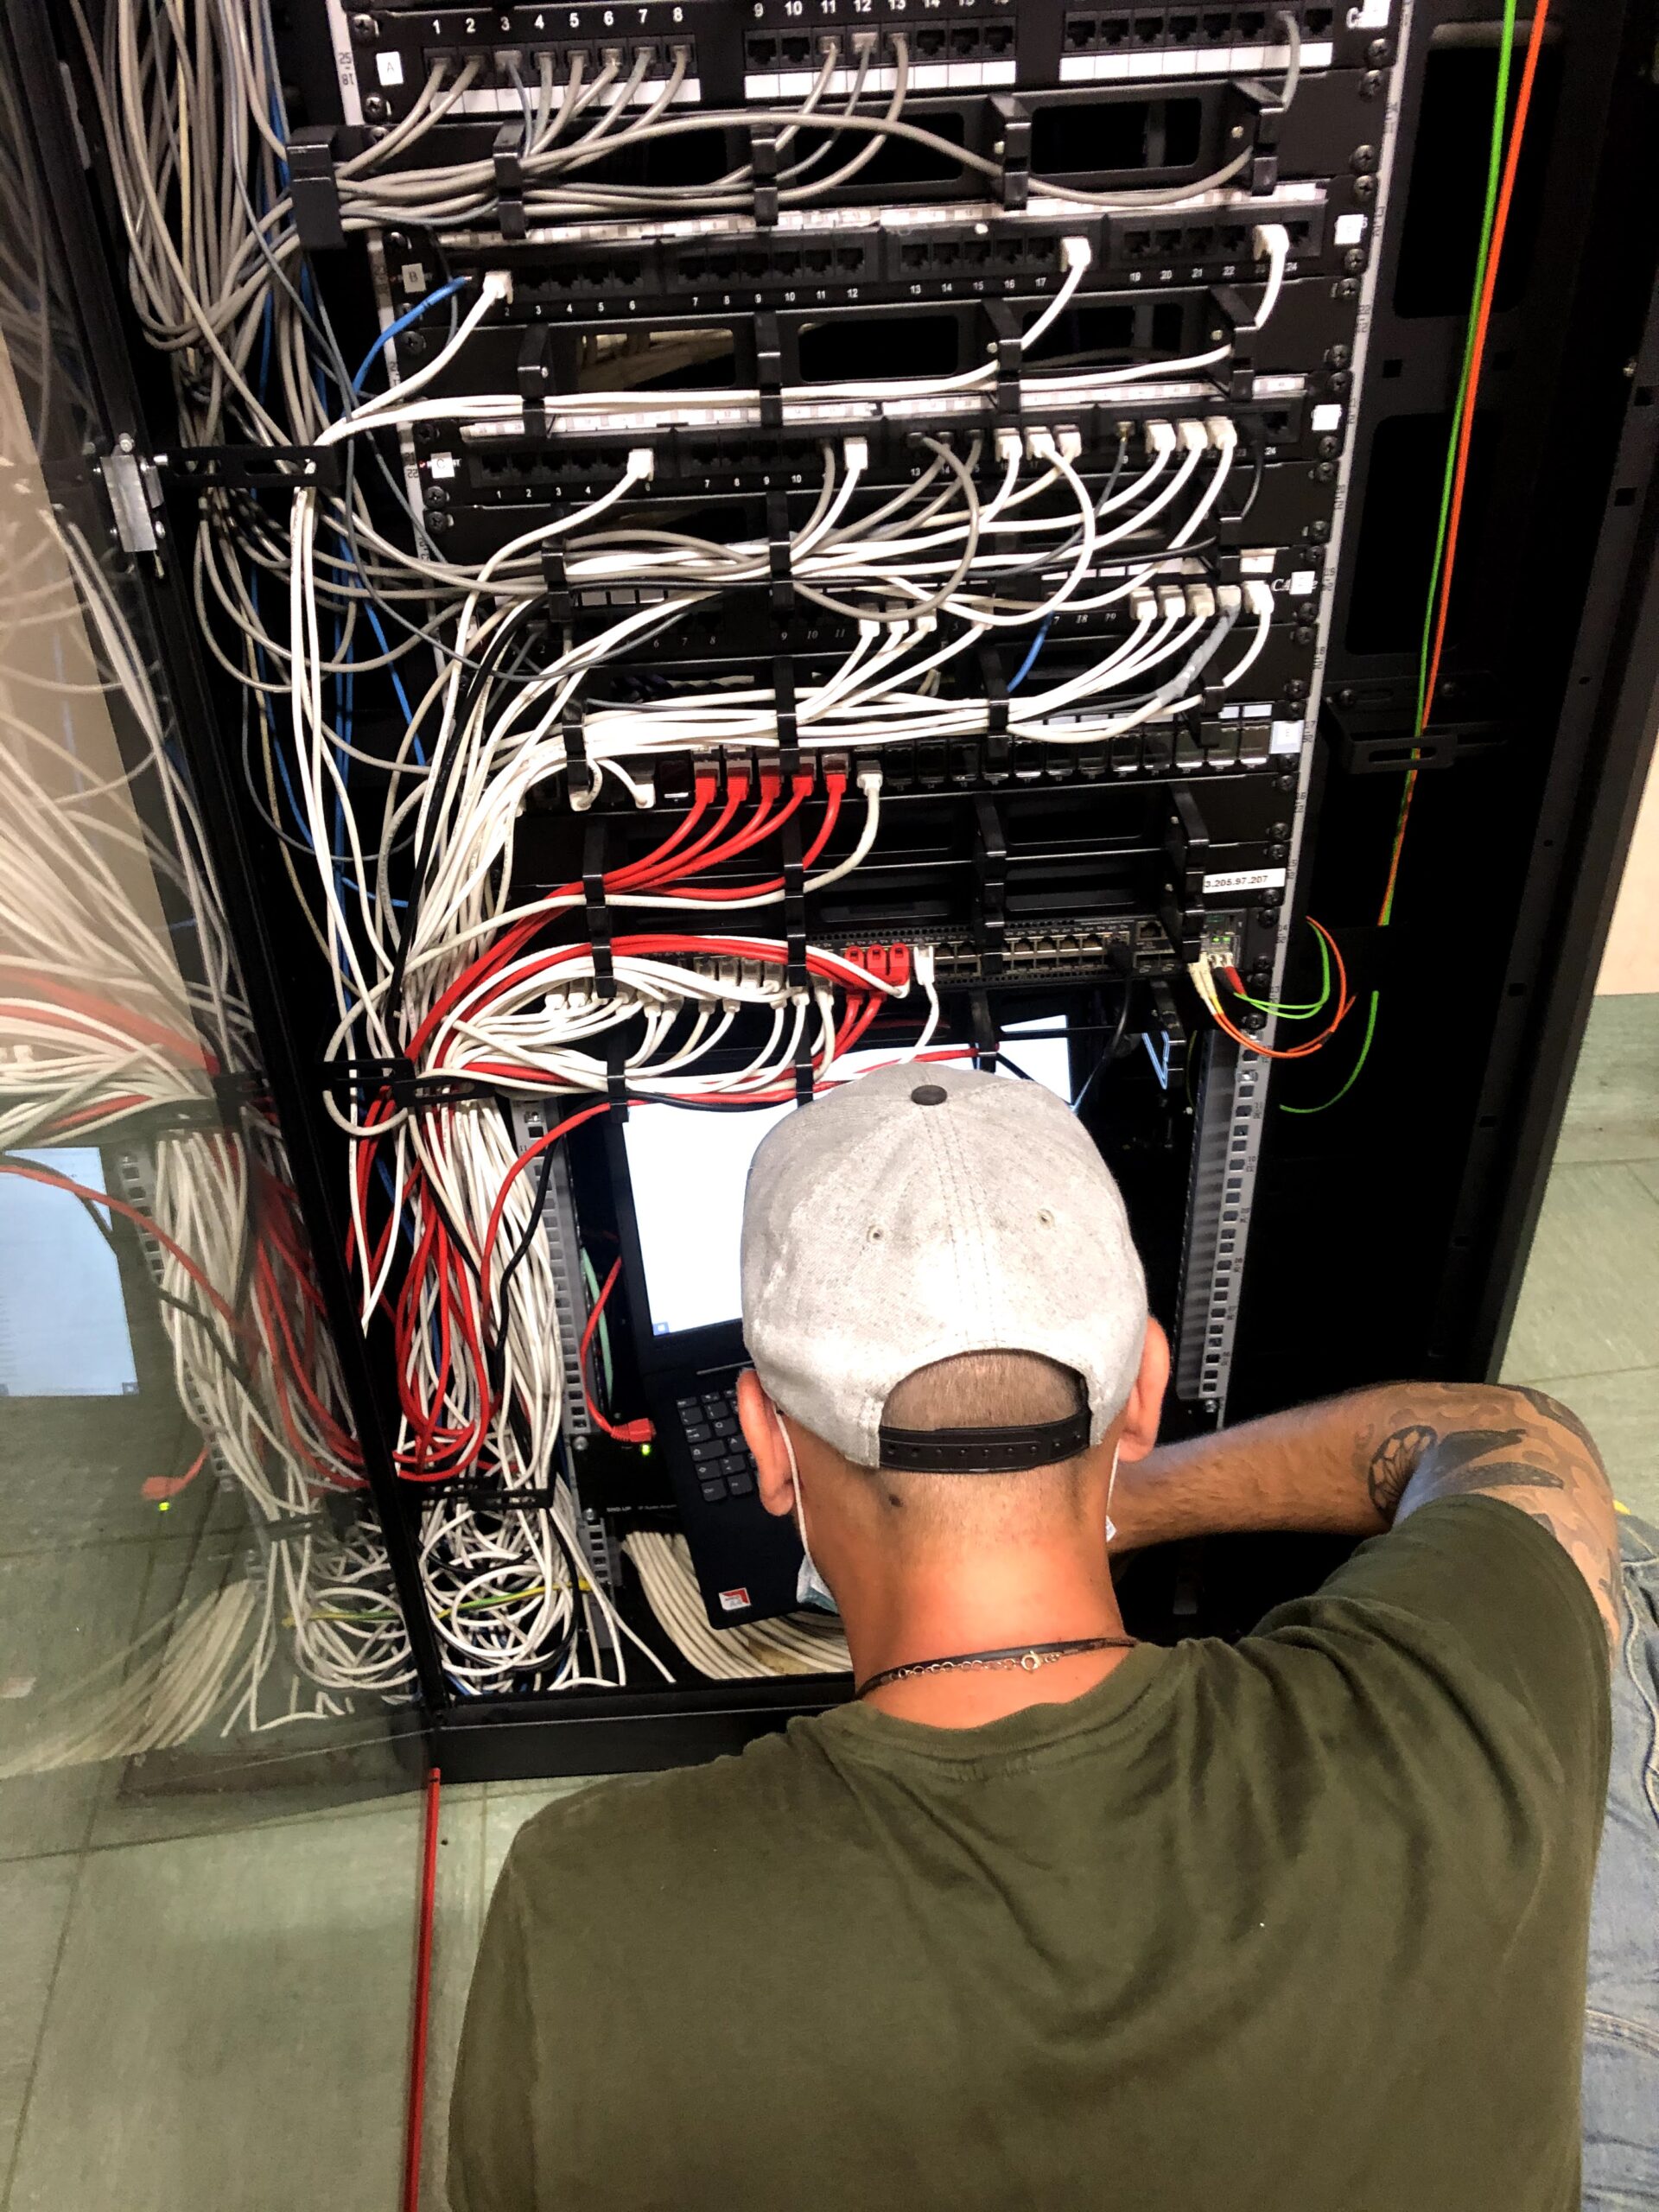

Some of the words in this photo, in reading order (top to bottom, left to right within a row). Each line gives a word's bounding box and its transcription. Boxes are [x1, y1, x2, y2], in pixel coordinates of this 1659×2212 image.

[753, 3, 764, 17] 9
[785, 1, 803, 16] 10
[822, 0, 836, 14] 11
[854, 0, 872, 12] 12
[433, 19, 441, 35] 1
[465, 17, 476, 34] 2
[500, 16, 511, 31] 3
[534, 14, 545, 29] 4
[569, 12, 580, 28] 5
[604, 10, 614, 26] 6
[639, 9, 648, 24] 7
[672, 7, 683, 22] 8
[386, 62, 394, 73] A
[410, 271, 417, 282] B
[1160, 270, 1173, 280] 20
[1192, 269, 1203, 278] 21
[1223, 266, 1235, 276] 22
[1285, 263, 1297, 271] 24
[910, 285, 921, 294] 13
[942, 283, 952, 292] 14
[973, 282, 983, 290] 15
[1004, 279, 1015, 289] 16
[1035, 277, 1046, 287] 17
[693, 297, 699, 307] 7
[724, 296, 730, 305] 8
[755, 294, 761, 303] 9
[785, 292, 796, 302] 10
[817, 290, 826, 300] 11
[847, 289, 859, 298] 12
[536, 305, 542, 315] 3
[566, 303, 573, 313] 4
[598, 302, 604, 312] 5
[629, 300, 635, 310] 6
[1264, 446, 1277, 455] 24
[436, 459, 445, 469] C
[911, 467, 921, 476] 13
[704, 480, 710, 488] 7
[734, 478, 741, 487] 8
[764, 476, 770, 485] 9
[791, 474, 803, 483] 10
[497, 490, 502, 499] 1
[526, 489, 531, 498] 2
[556, 487, 562, 496] 3
[585, 486, 591, 494] 4
[1077, 614, 1088, 623] 18
[781, 632, 787, 640] 9
[807, 630, 818, 639] 10
[835, 629, 845, 638] 11
[653, 639, 659, 648] 6
[682, 637, 688, 645] 7
[709, 635, 716, 645] 8
